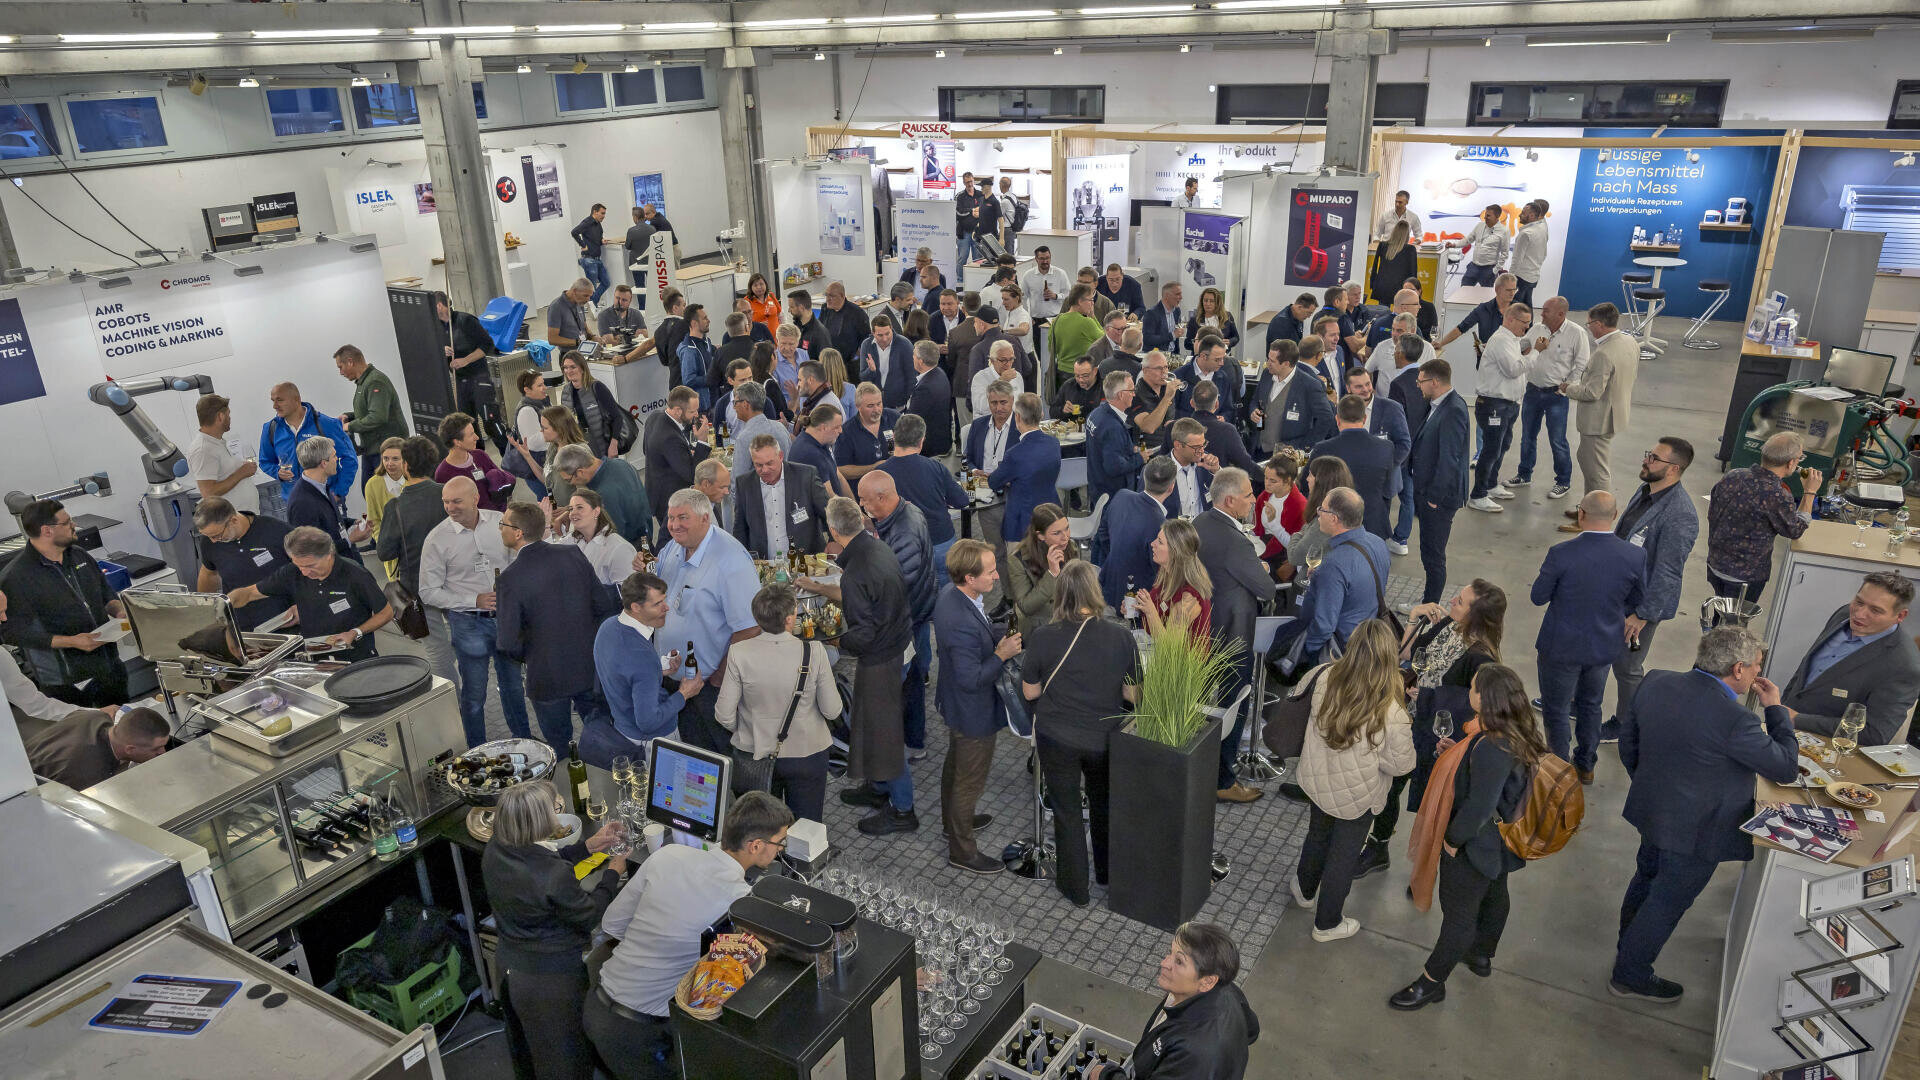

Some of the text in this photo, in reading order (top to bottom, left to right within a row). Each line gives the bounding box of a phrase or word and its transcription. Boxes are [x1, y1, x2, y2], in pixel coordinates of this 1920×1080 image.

[901, 122, 950, 138] RAUSSER
[1218, 144, 1277, 157] Ihr odukt
[1467, 145, 1510, 158] GUMA
[1595, 162, 1705, 178] Lebensmittel
[1592, 179, 1678, 194] nach Mass
[1309, 194, 1353, 204] MUPARO
[1591, 196, 1683, 206] Individuelle Rezepturen
[1606, 206, 1662, 216] Verpackungen
[172, 274, 211, 287] CHROMOS
[95, 303, 124, 316] AMR
[98, 312, 151, 330] COBOTS
[102, 317, 204, 344] MACHINE VISION
[105, 327, 224, 358] CODING & MARKING
[641, 398, 668, 413] CHRO
